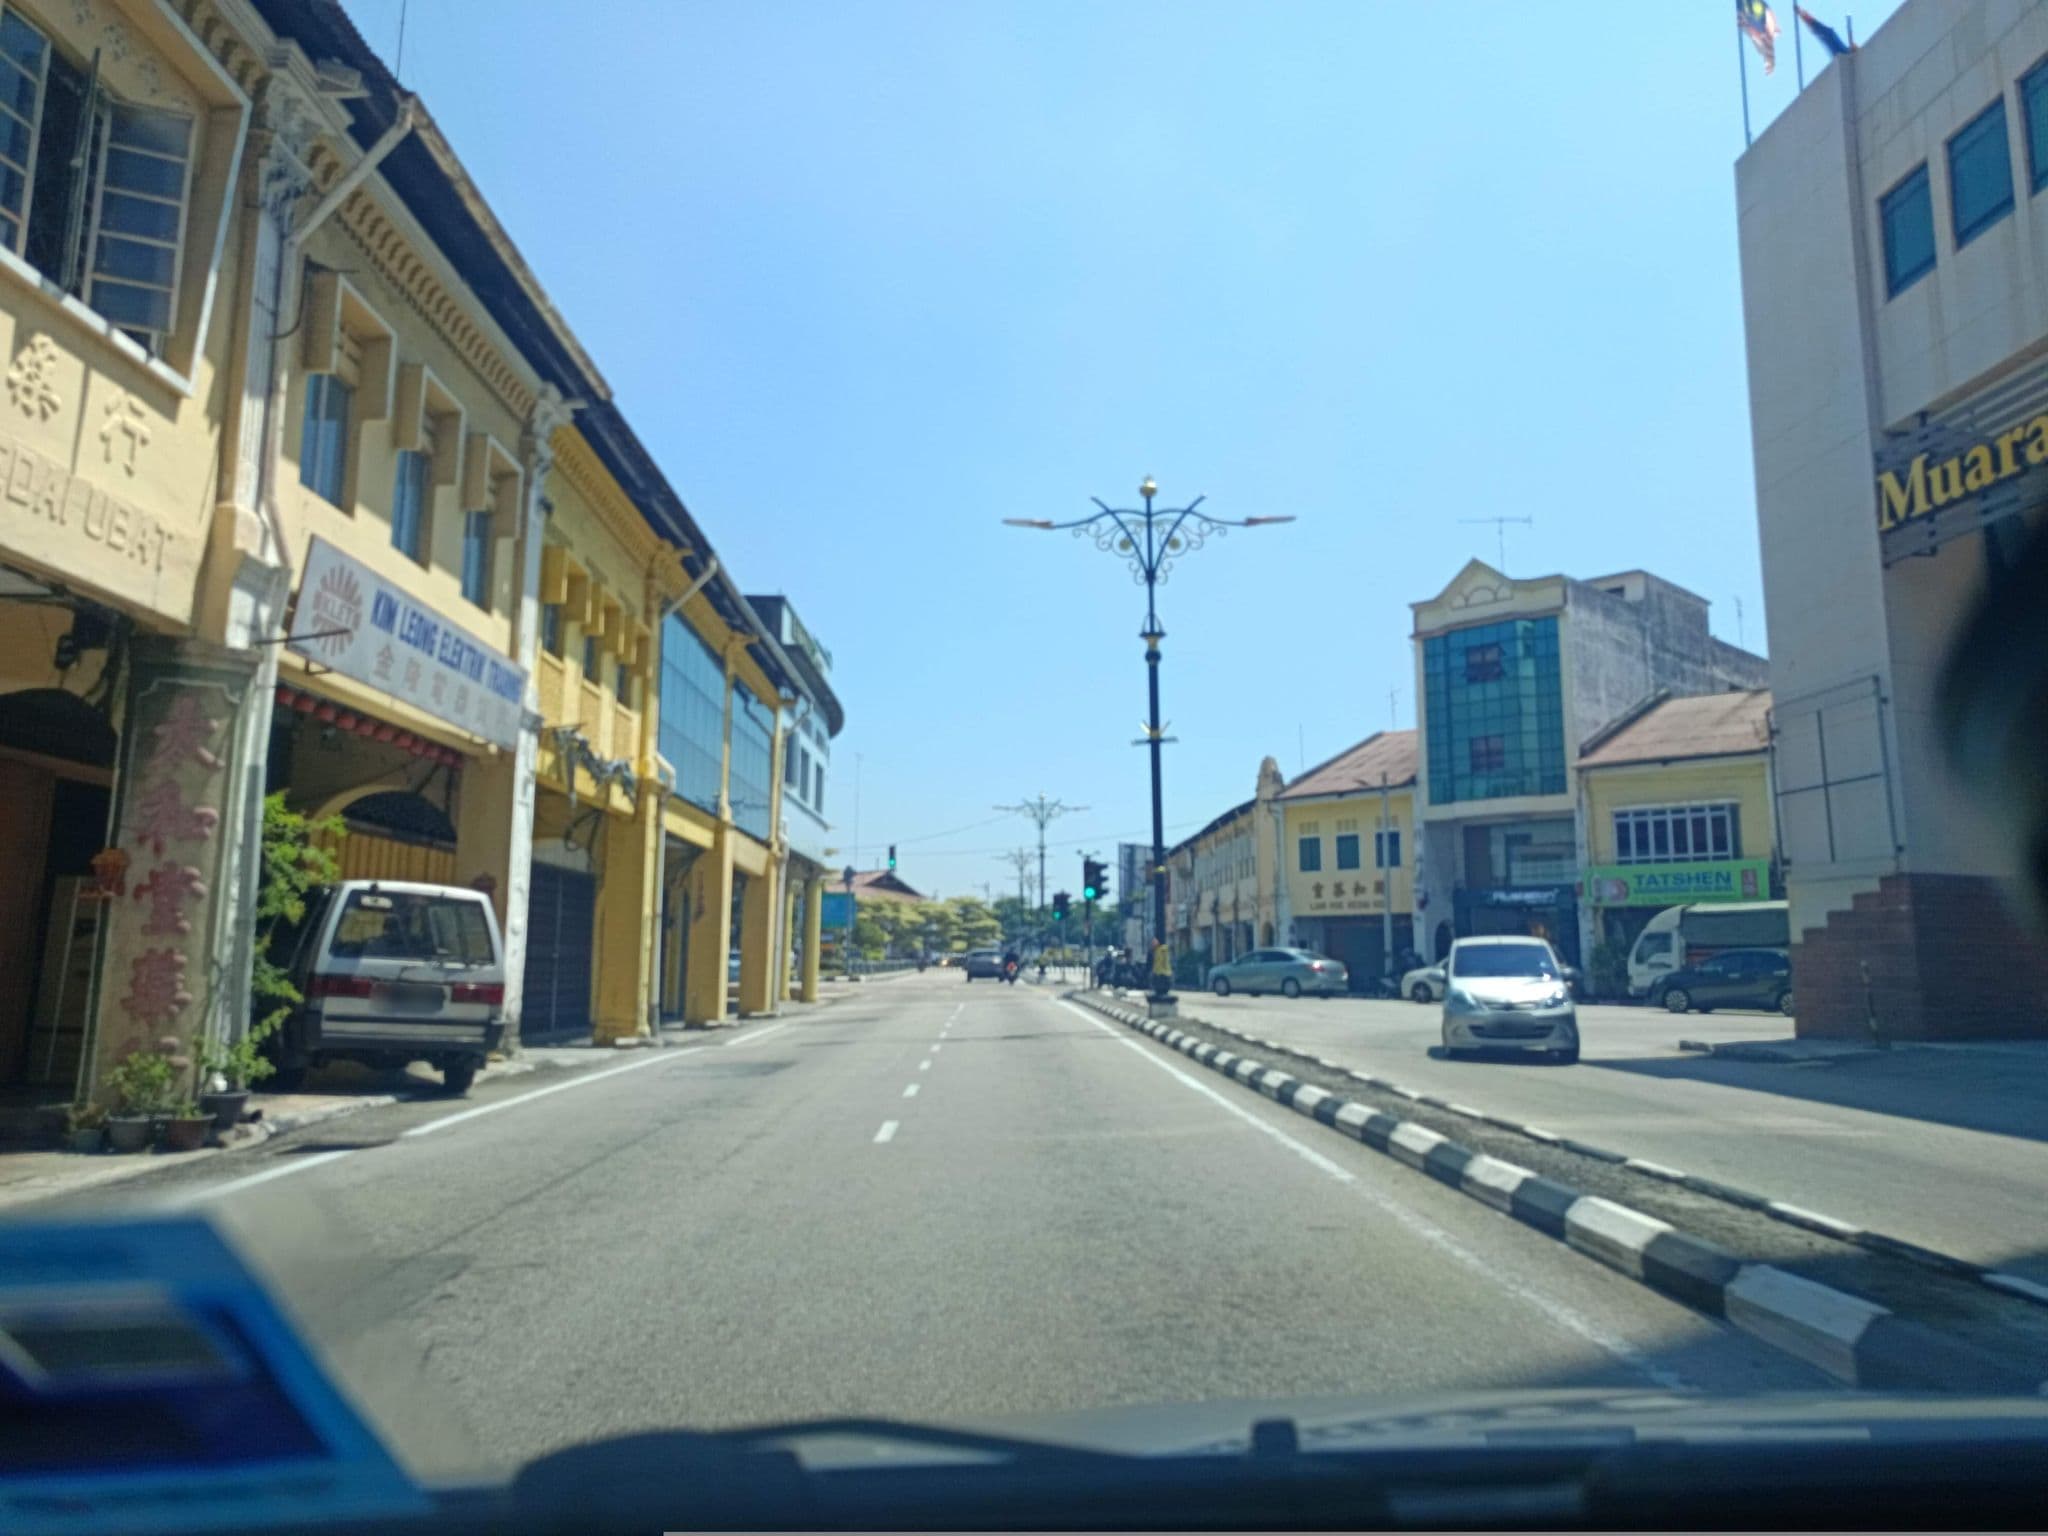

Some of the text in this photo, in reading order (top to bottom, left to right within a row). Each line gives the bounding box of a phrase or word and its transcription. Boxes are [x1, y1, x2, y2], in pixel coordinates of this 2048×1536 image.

[1876, 413, 2048, 531] Muara
[372, 589, 398, 634] KIM
[399, 605, 437, 656] LEONG
[1633, 871, 1732, 887] TATSHEN
